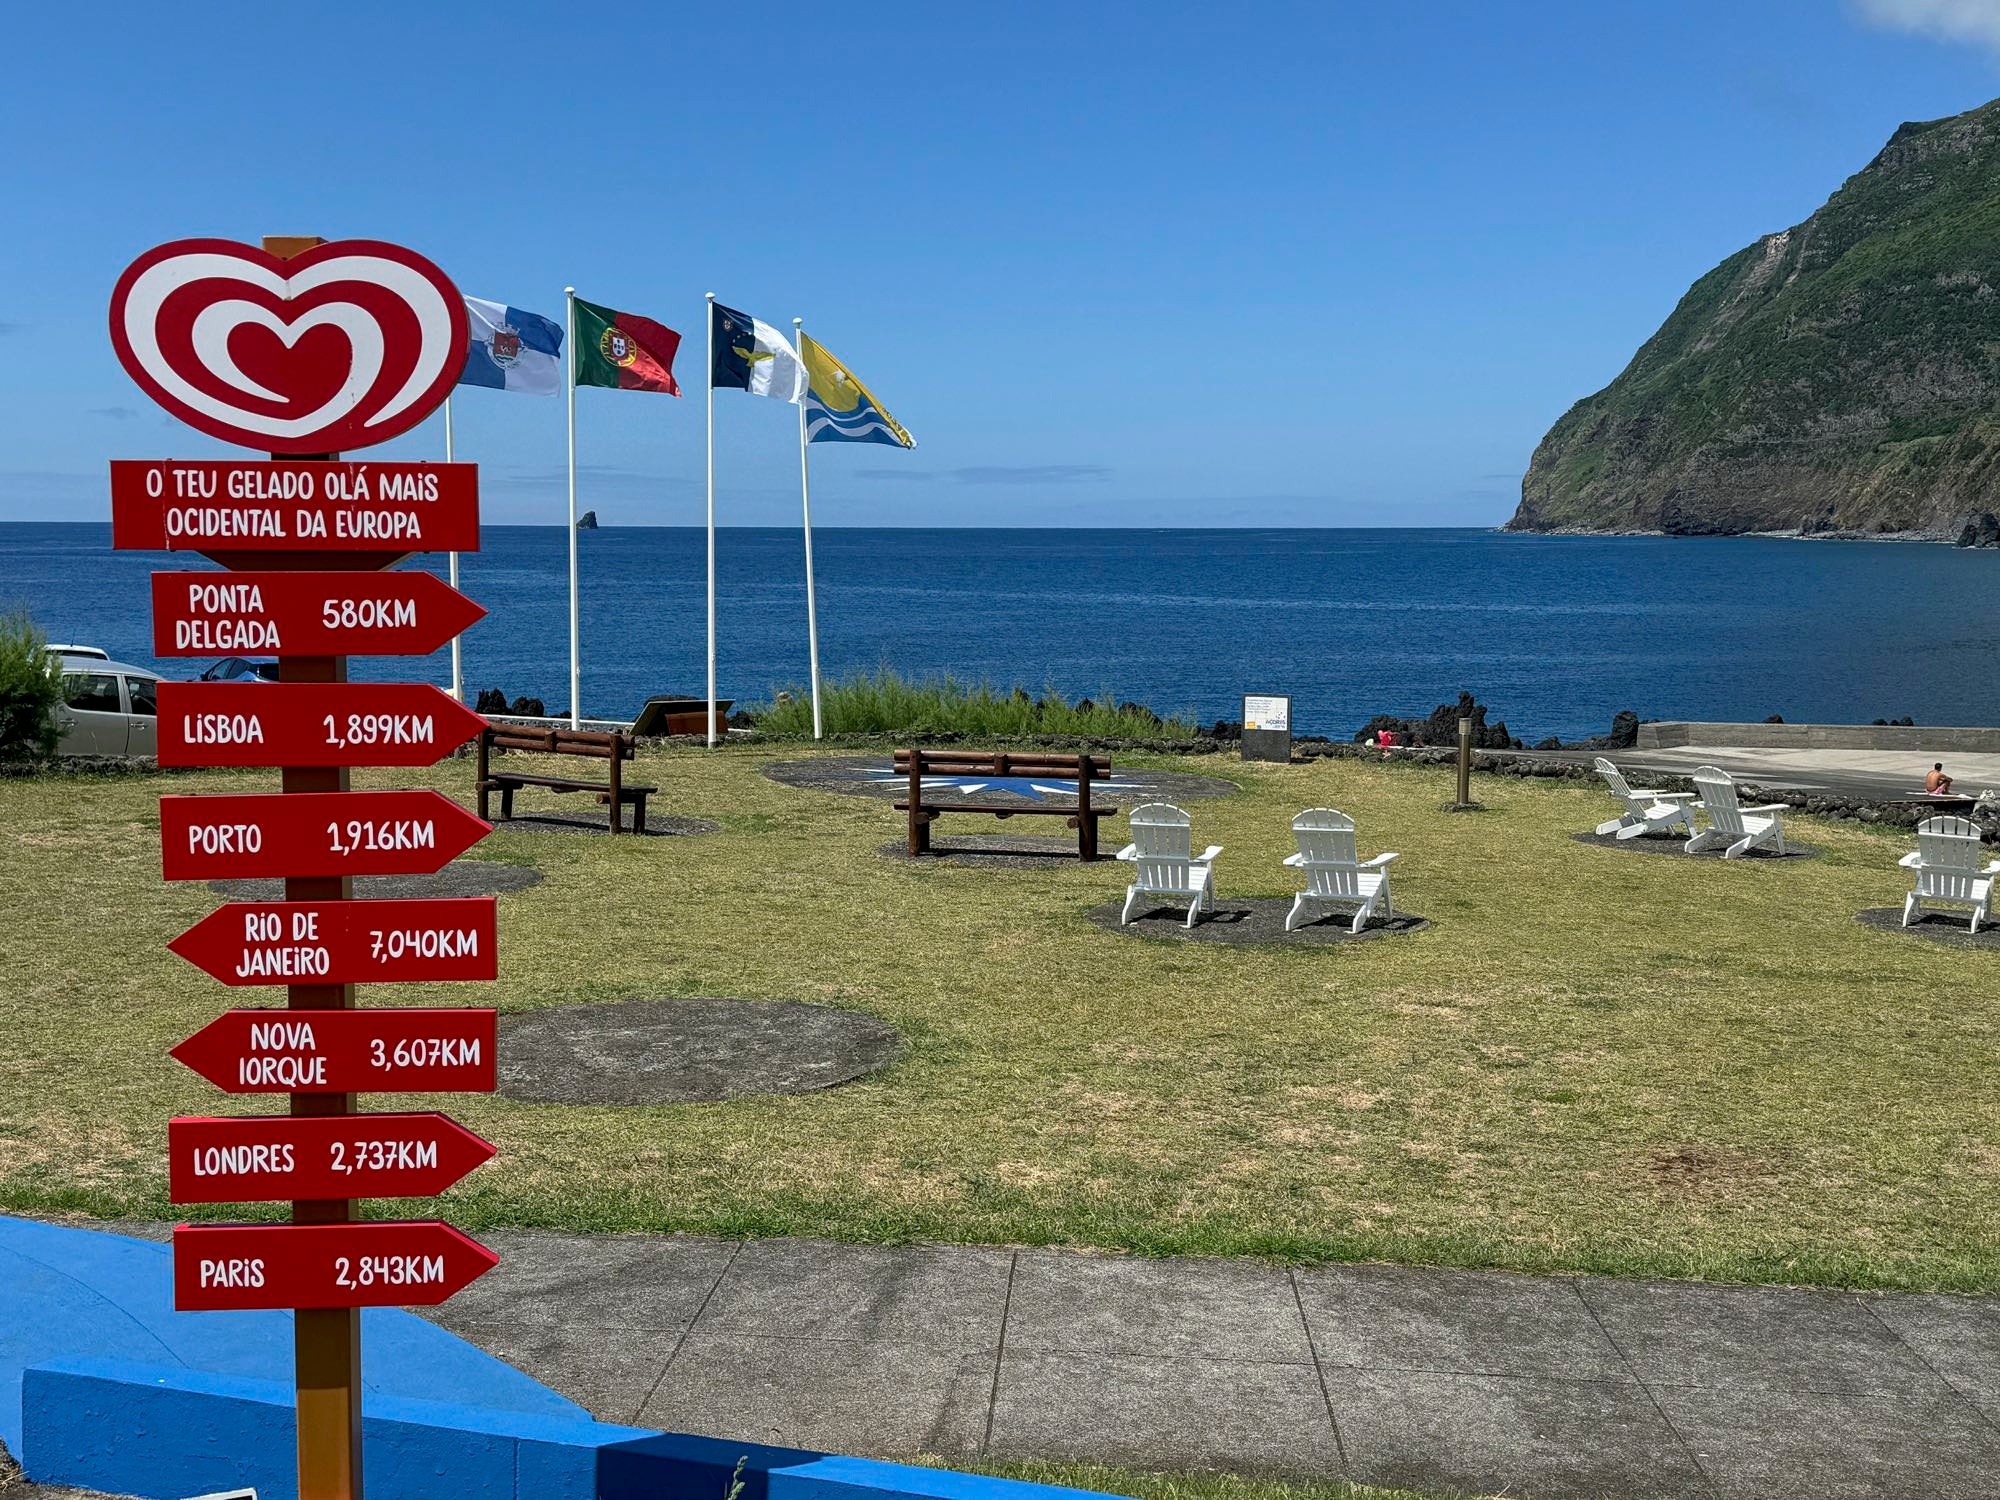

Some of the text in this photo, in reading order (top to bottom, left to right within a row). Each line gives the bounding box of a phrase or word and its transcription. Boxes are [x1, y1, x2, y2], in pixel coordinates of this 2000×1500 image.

[146, 468, 163, 498] O
[172, 469, 217, 498] TEU
[227, 470, 315, 500] GELADO
[324, 465, 370, 501] OLÁ
[166, 507, 422, 539] OCIDENTAL DA EUROPA
[189, 584, 265, 614] PONTA
[322, 598, 417, 629] 580KM
[175, 619, 281, 650] DELGADA
[323, 714, 434, 749] 1,899KM
[188, 819, 435, 856] PORTO 1,916KM
[292, 912, 319, 941] DE
[369, 929, 478, 964] 7,040KM
[251, 1022, 316, 1051] NOVA
[370, 1038, 481, 1072] 3,607KM
[239, 1056, 327, 1088] IORQUE
[194, 1140, 437, 1176] LONDRES 2,737KM
[335, 1255, 444, 1291] 2,843KM
